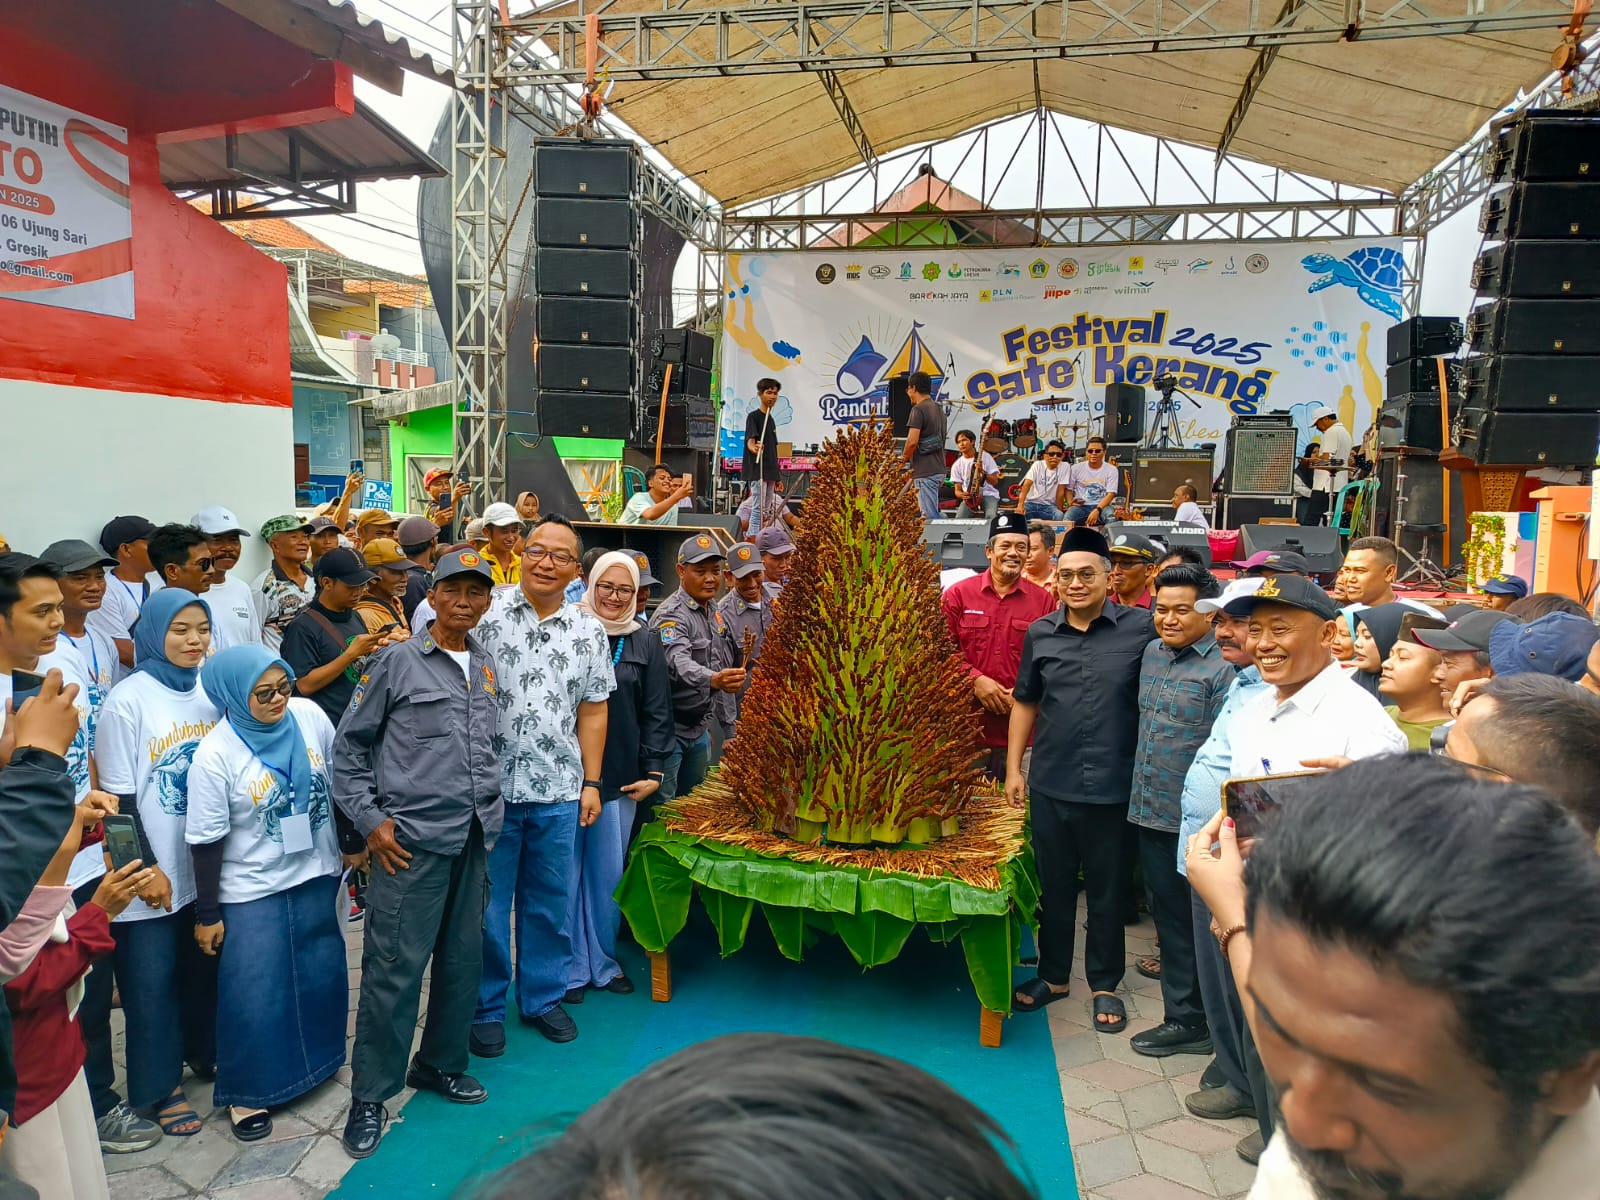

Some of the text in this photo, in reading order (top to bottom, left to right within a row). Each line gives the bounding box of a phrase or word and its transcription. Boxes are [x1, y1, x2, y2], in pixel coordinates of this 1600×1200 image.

[0, 107, 58, 147] PUTIH
[10, 191, 40, 208] 2025
[1, 214, 88, 246] 06 Ujung Sari
[6, 238, 49, 258] Gresik
[0, 260, 73, 283] o@gmail.com
[992, 288, 1012, 296] PLN
[1114, 286, 1152, 295] wilmar
[1003, 312, 1272, 365] Festival 2025
[967, 345, 1273, 415] Sate Kerang
[1075, 401, 1090, 412] 25
[1148, 400, 1182, 411] 205
[1170, 527, 1205, 535] AUDIO
